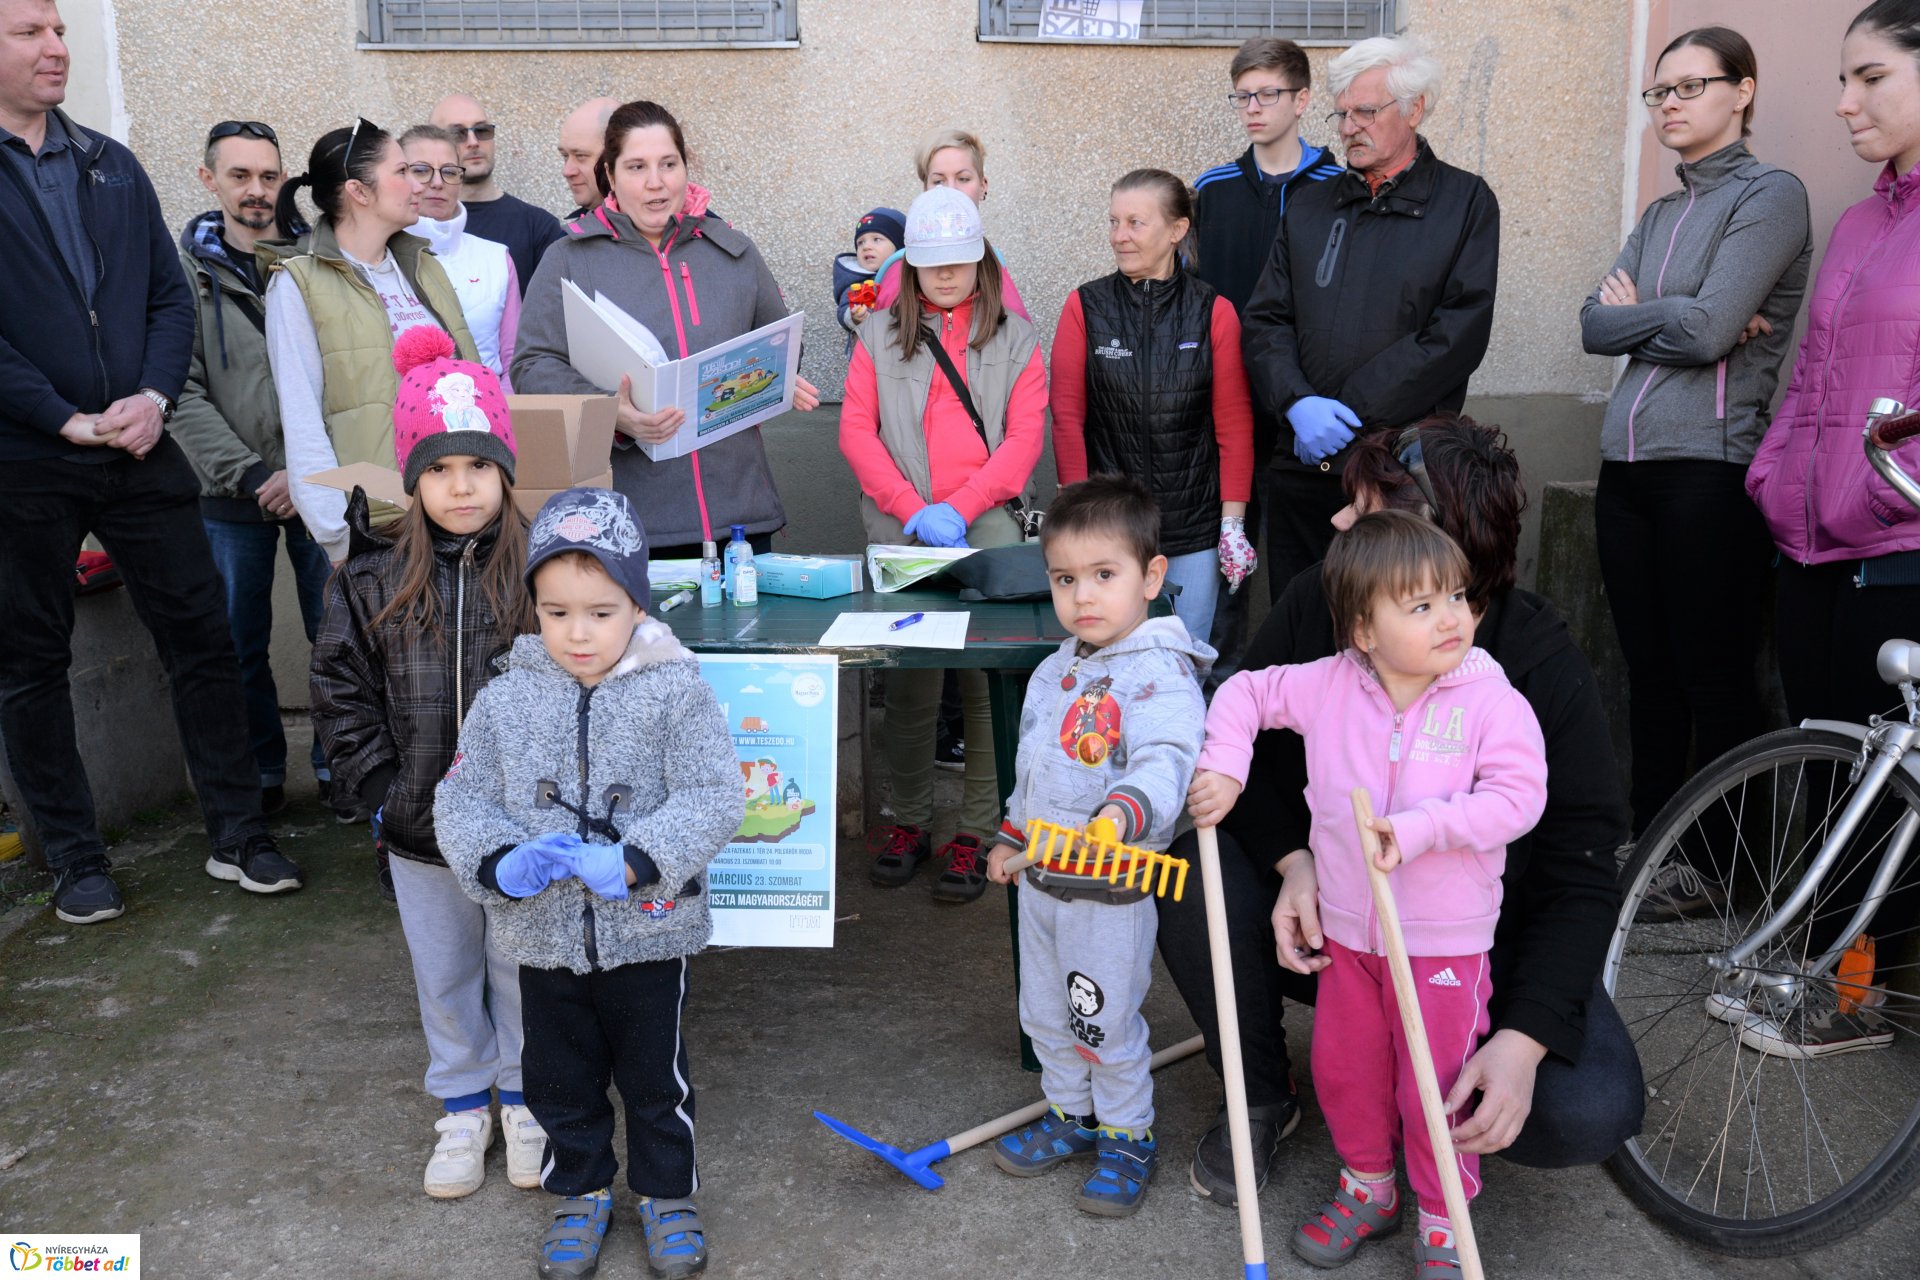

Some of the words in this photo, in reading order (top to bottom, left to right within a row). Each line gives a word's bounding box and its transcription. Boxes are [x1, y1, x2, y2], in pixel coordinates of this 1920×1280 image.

[1042, 11, 1139, 40] SZEDD!
[709, 871, 753, 886] MÁRCIUS
[754, 876, 767, 886] 23.
[768, 876, 802, 887] SZOMBAT
[737, 892, 824, 907] MAGYARORSZÁGÉRT
[1428, 977, 1462, 986] adidas
